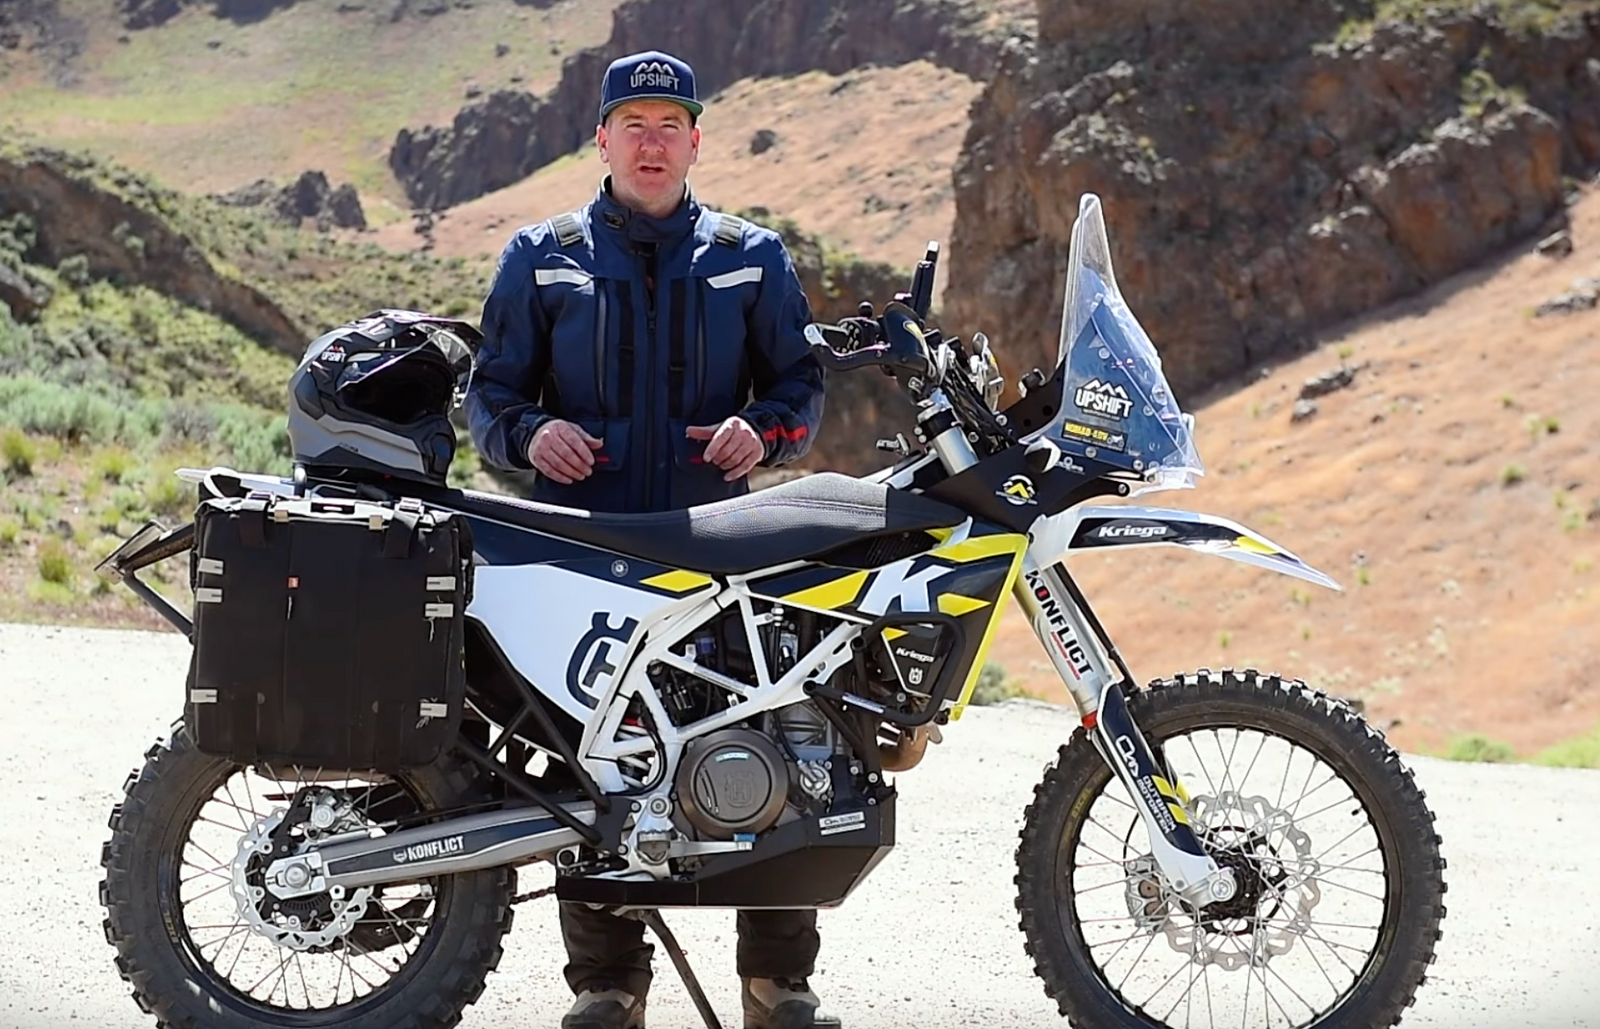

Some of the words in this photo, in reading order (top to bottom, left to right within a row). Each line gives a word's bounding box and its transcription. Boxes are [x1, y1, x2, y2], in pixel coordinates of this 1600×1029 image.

[630, 73, 680, 91] UPSHIFT
[1075, 388, 1133, 418] UPSHIFT
[1098, 525, 1167, 538] Kriega
[857, 560, 956, 617] K
[1025, 570, 1094, 675] KONFLICT
[896, 647, 935, 663] Kriega
[1142, 775, 1177, 831] OUTBACK
[407, 835, 464, 861] KONFLICT
